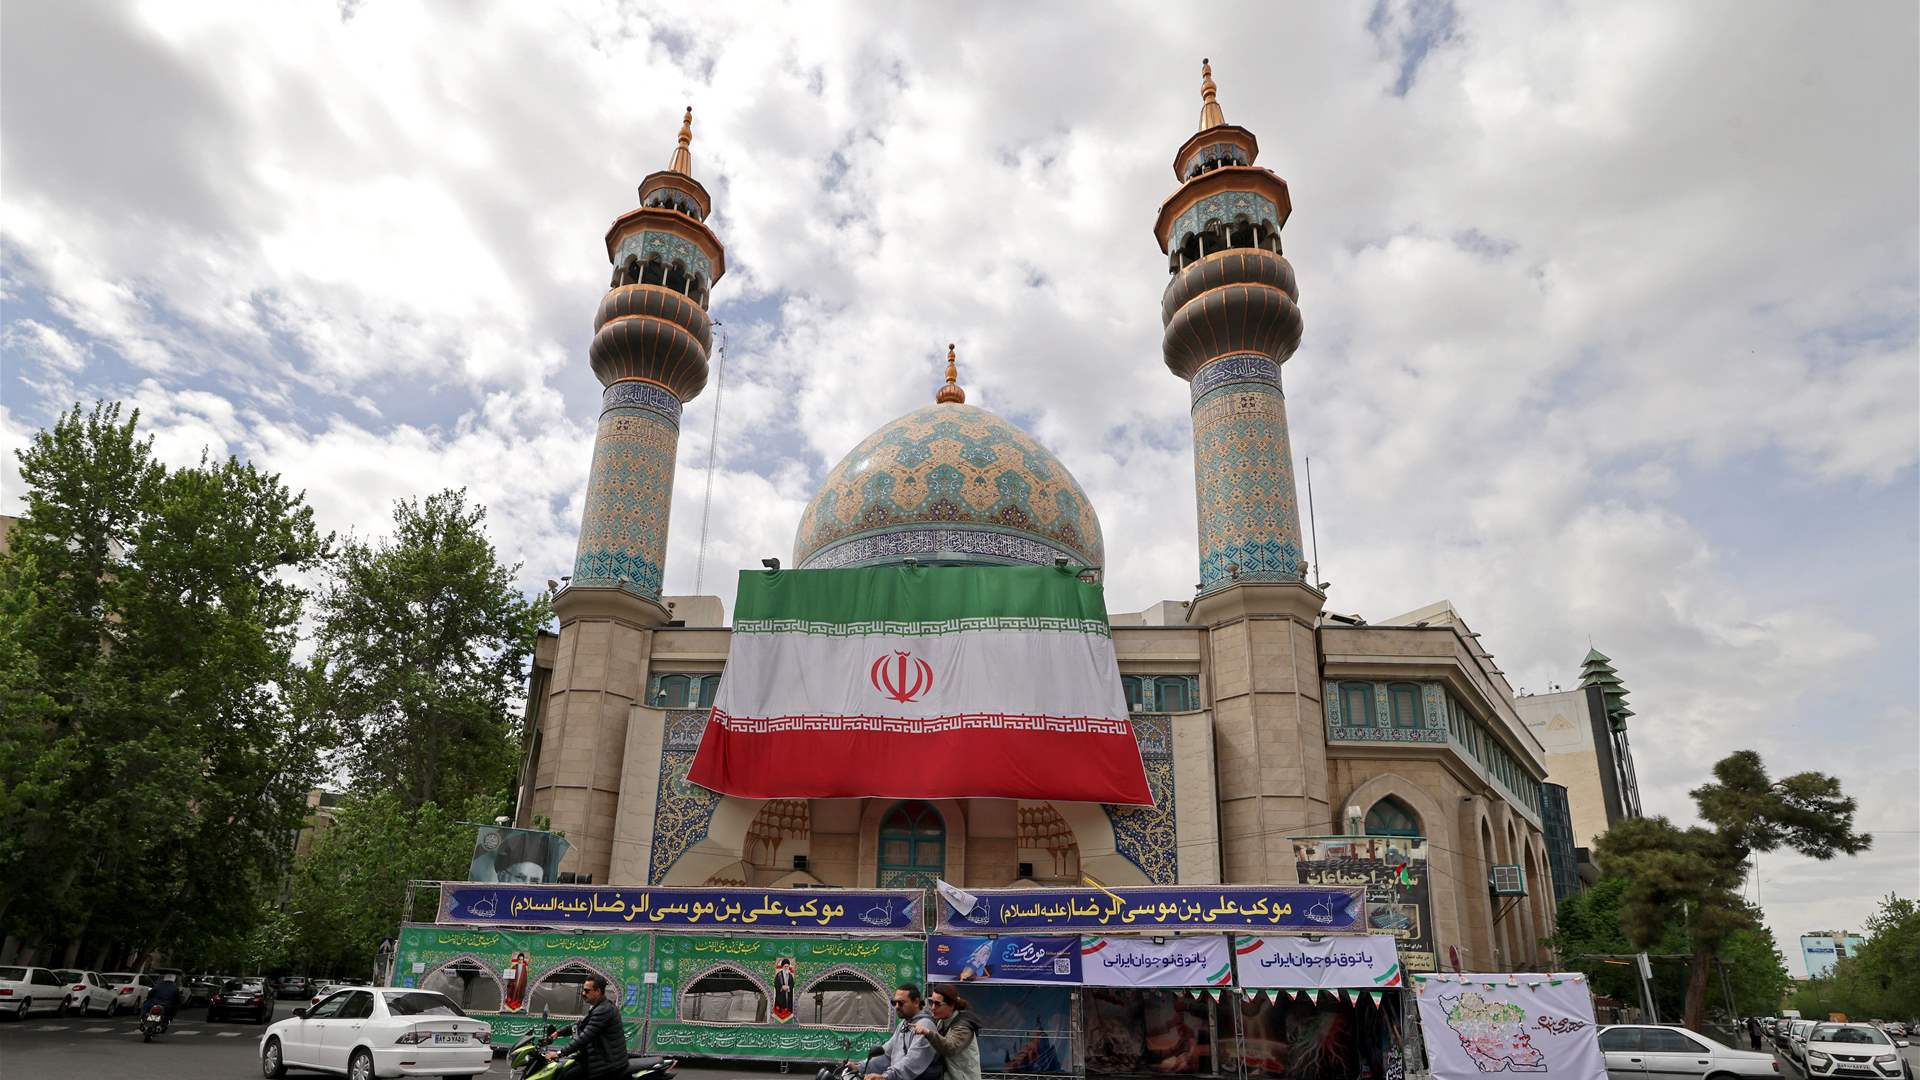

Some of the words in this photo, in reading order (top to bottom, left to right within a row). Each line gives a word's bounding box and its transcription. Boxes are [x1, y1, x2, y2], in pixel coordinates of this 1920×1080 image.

[650, 901, 713, 922] موسی
[715, 898, 741, 922] بن
[742, 896, 783, 923] علی
[784, 897, 844, 926] موکب
[1122, 902, 1177, 923] موسی
[1179, 899, 1200, 922] بن
[1203, 896, 1239, 922] علی
[1240, 898, 1292, 923] موکب
[1104, 953, 1132, 968] ایرانی
[1132, 953, 1174, 968] نوجوان
[1174, 952, 1206, 968] پاتوق
[1260, 952, 1292, 968] ایرانی
[1292, 952, 1337, 968] نوجوان
[1338, 952, 1373, 968] پاتوق
